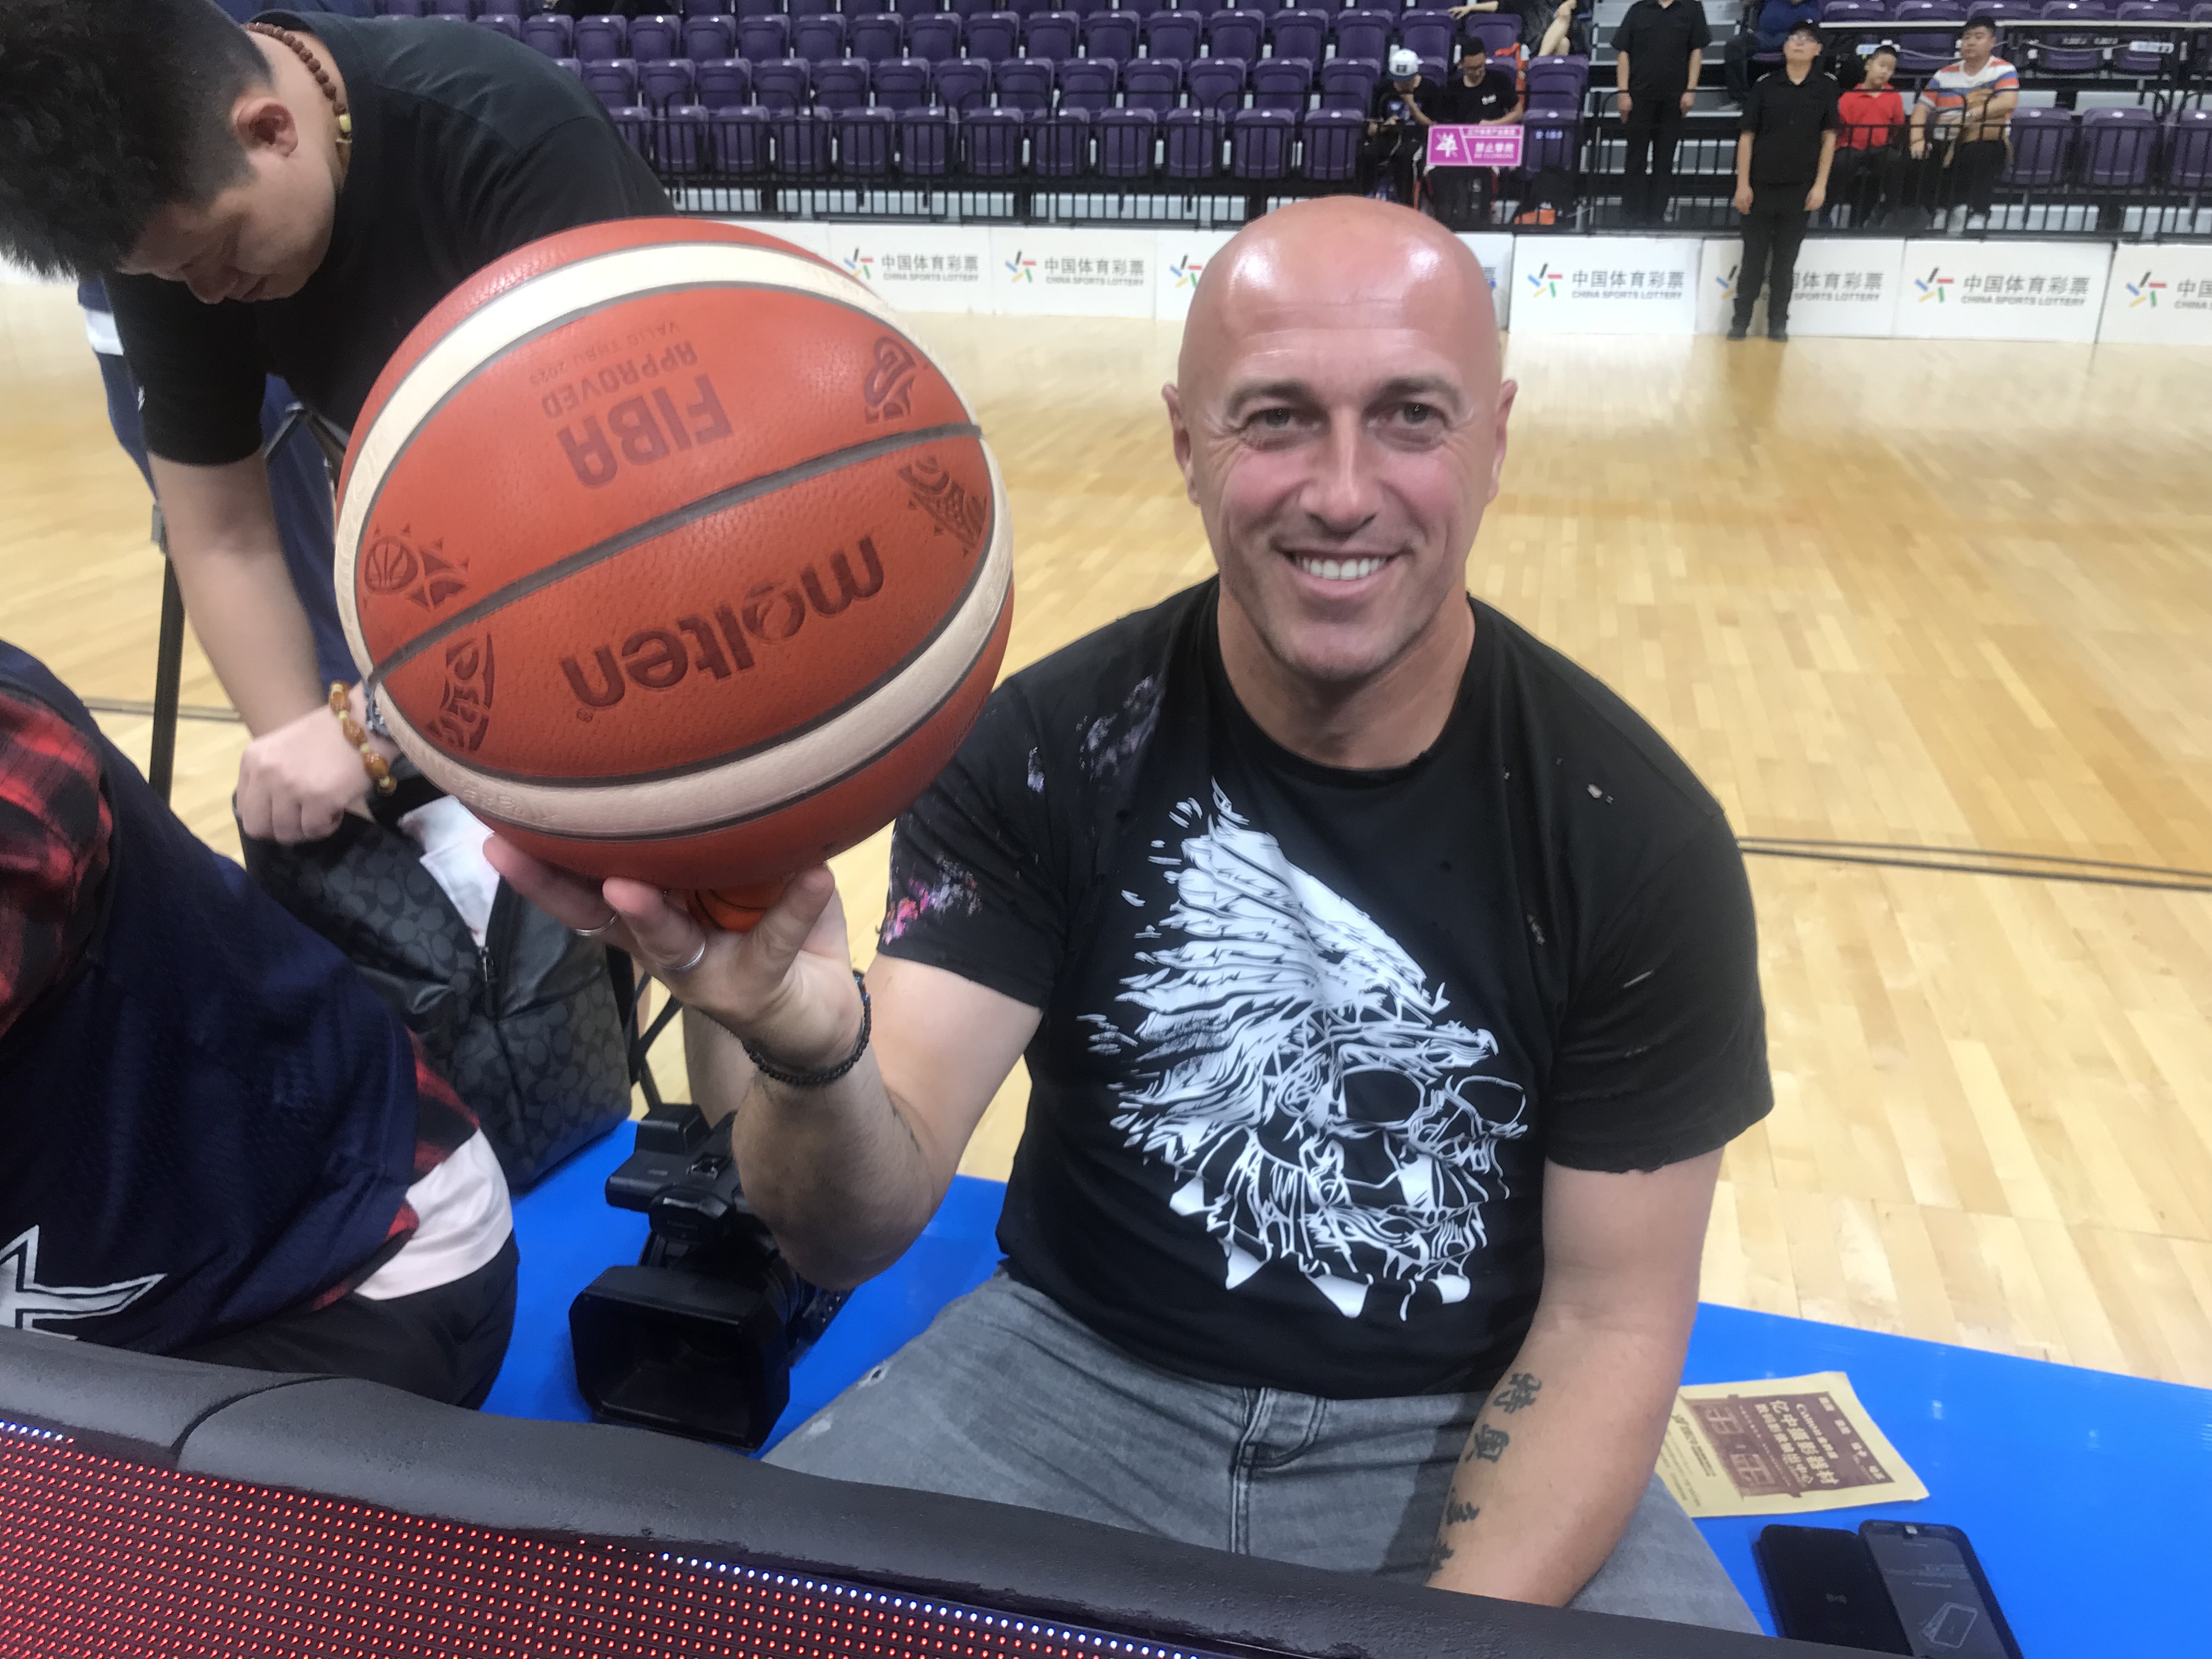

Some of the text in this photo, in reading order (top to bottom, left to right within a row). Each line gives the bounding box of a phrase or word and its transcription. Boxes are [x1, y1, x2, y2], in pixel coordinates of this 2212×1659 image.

[881, 253, 979, 272] 中国体育彩票
[1044, 257, 1146, 275] 中国体育彩票
[1572, 269, 1684, 288] 中国体育彩票
[1963, 273, 2090, 295] 中国体育彩票
[541, 339, 698, 419] APPROVED
[556, 373, 733, 489] FIBA
[559, 533, 885, 708] molten
